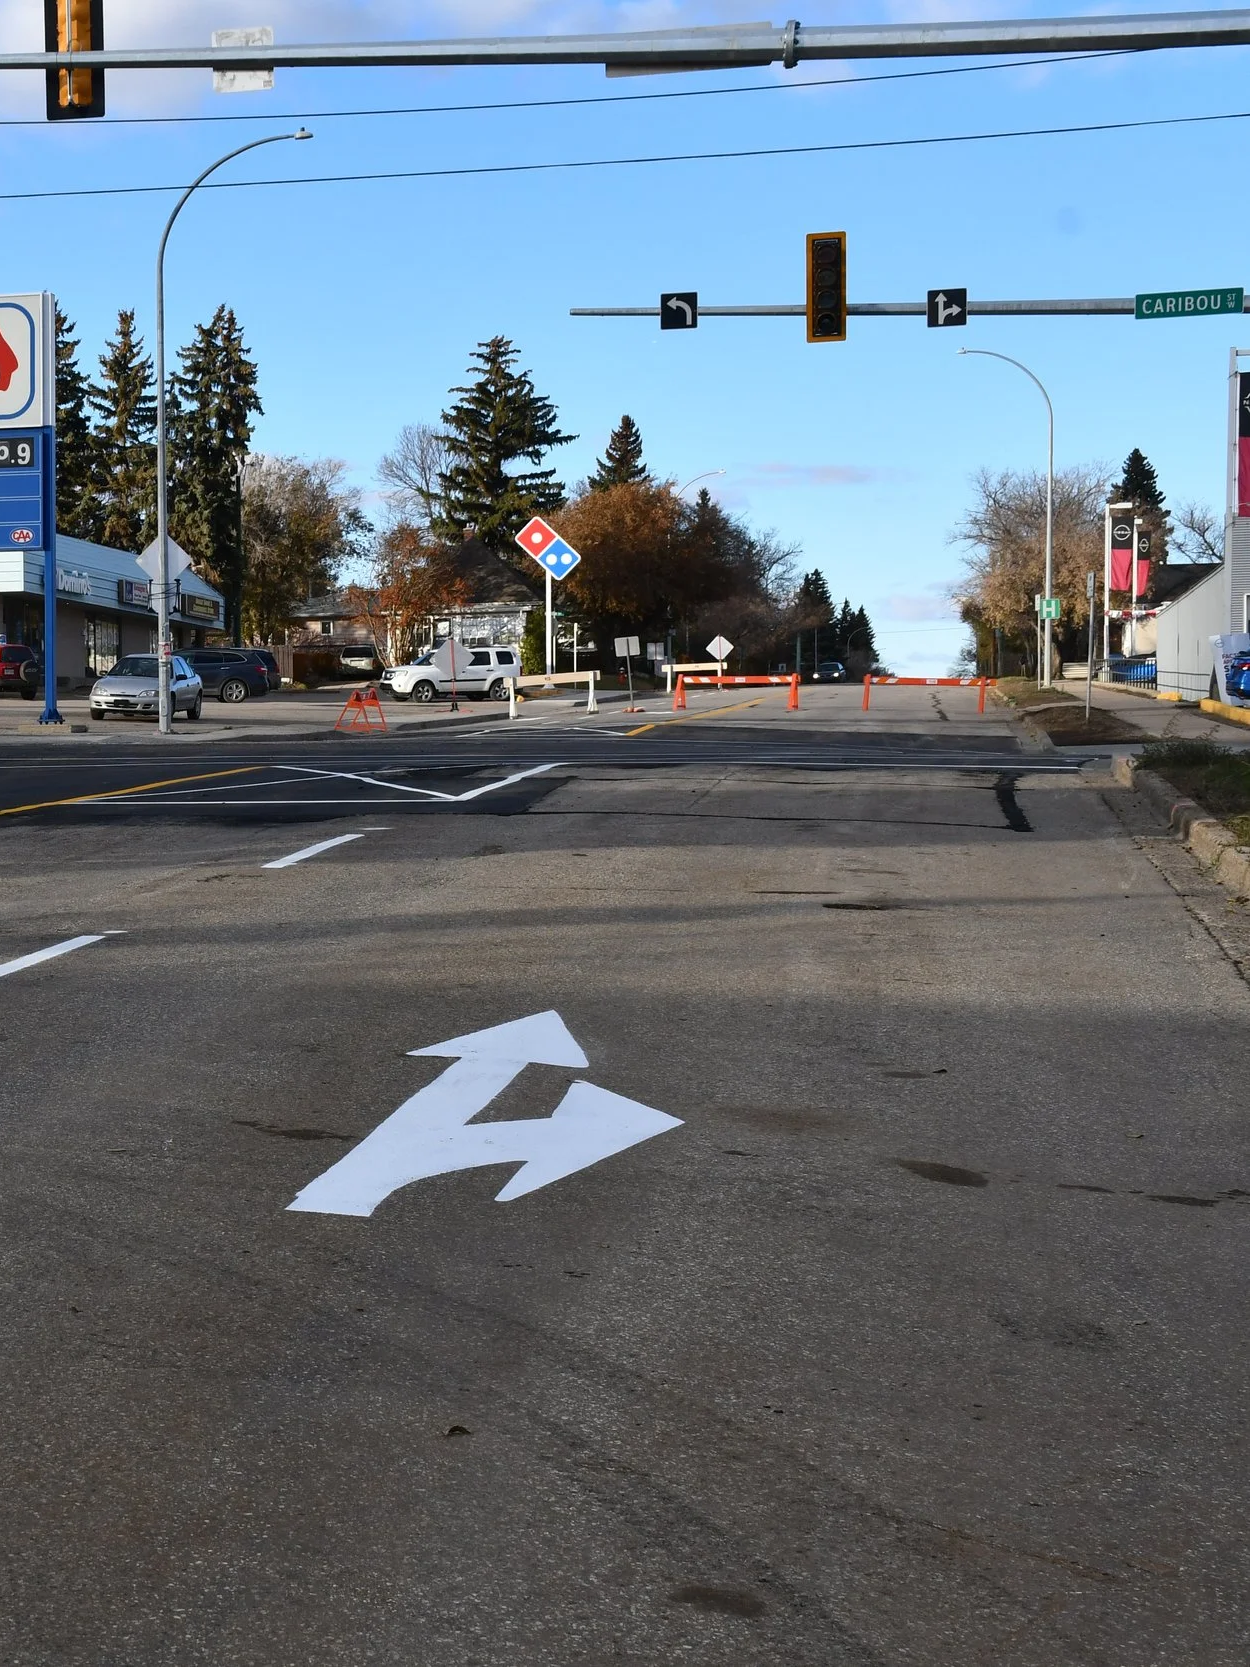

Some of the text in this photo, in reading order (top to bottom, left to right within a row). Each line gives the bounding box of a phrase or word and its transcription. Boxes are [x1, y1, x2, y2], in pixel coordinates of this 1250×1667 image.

[1142, 294, 1221, 314] CARIBOU
[1227, 293, 1237, 302] ST
[13, 530, 30, 541] CAA
[56, 568, 92, 596] Domino's
[1043, 600, 1055, 617] H
